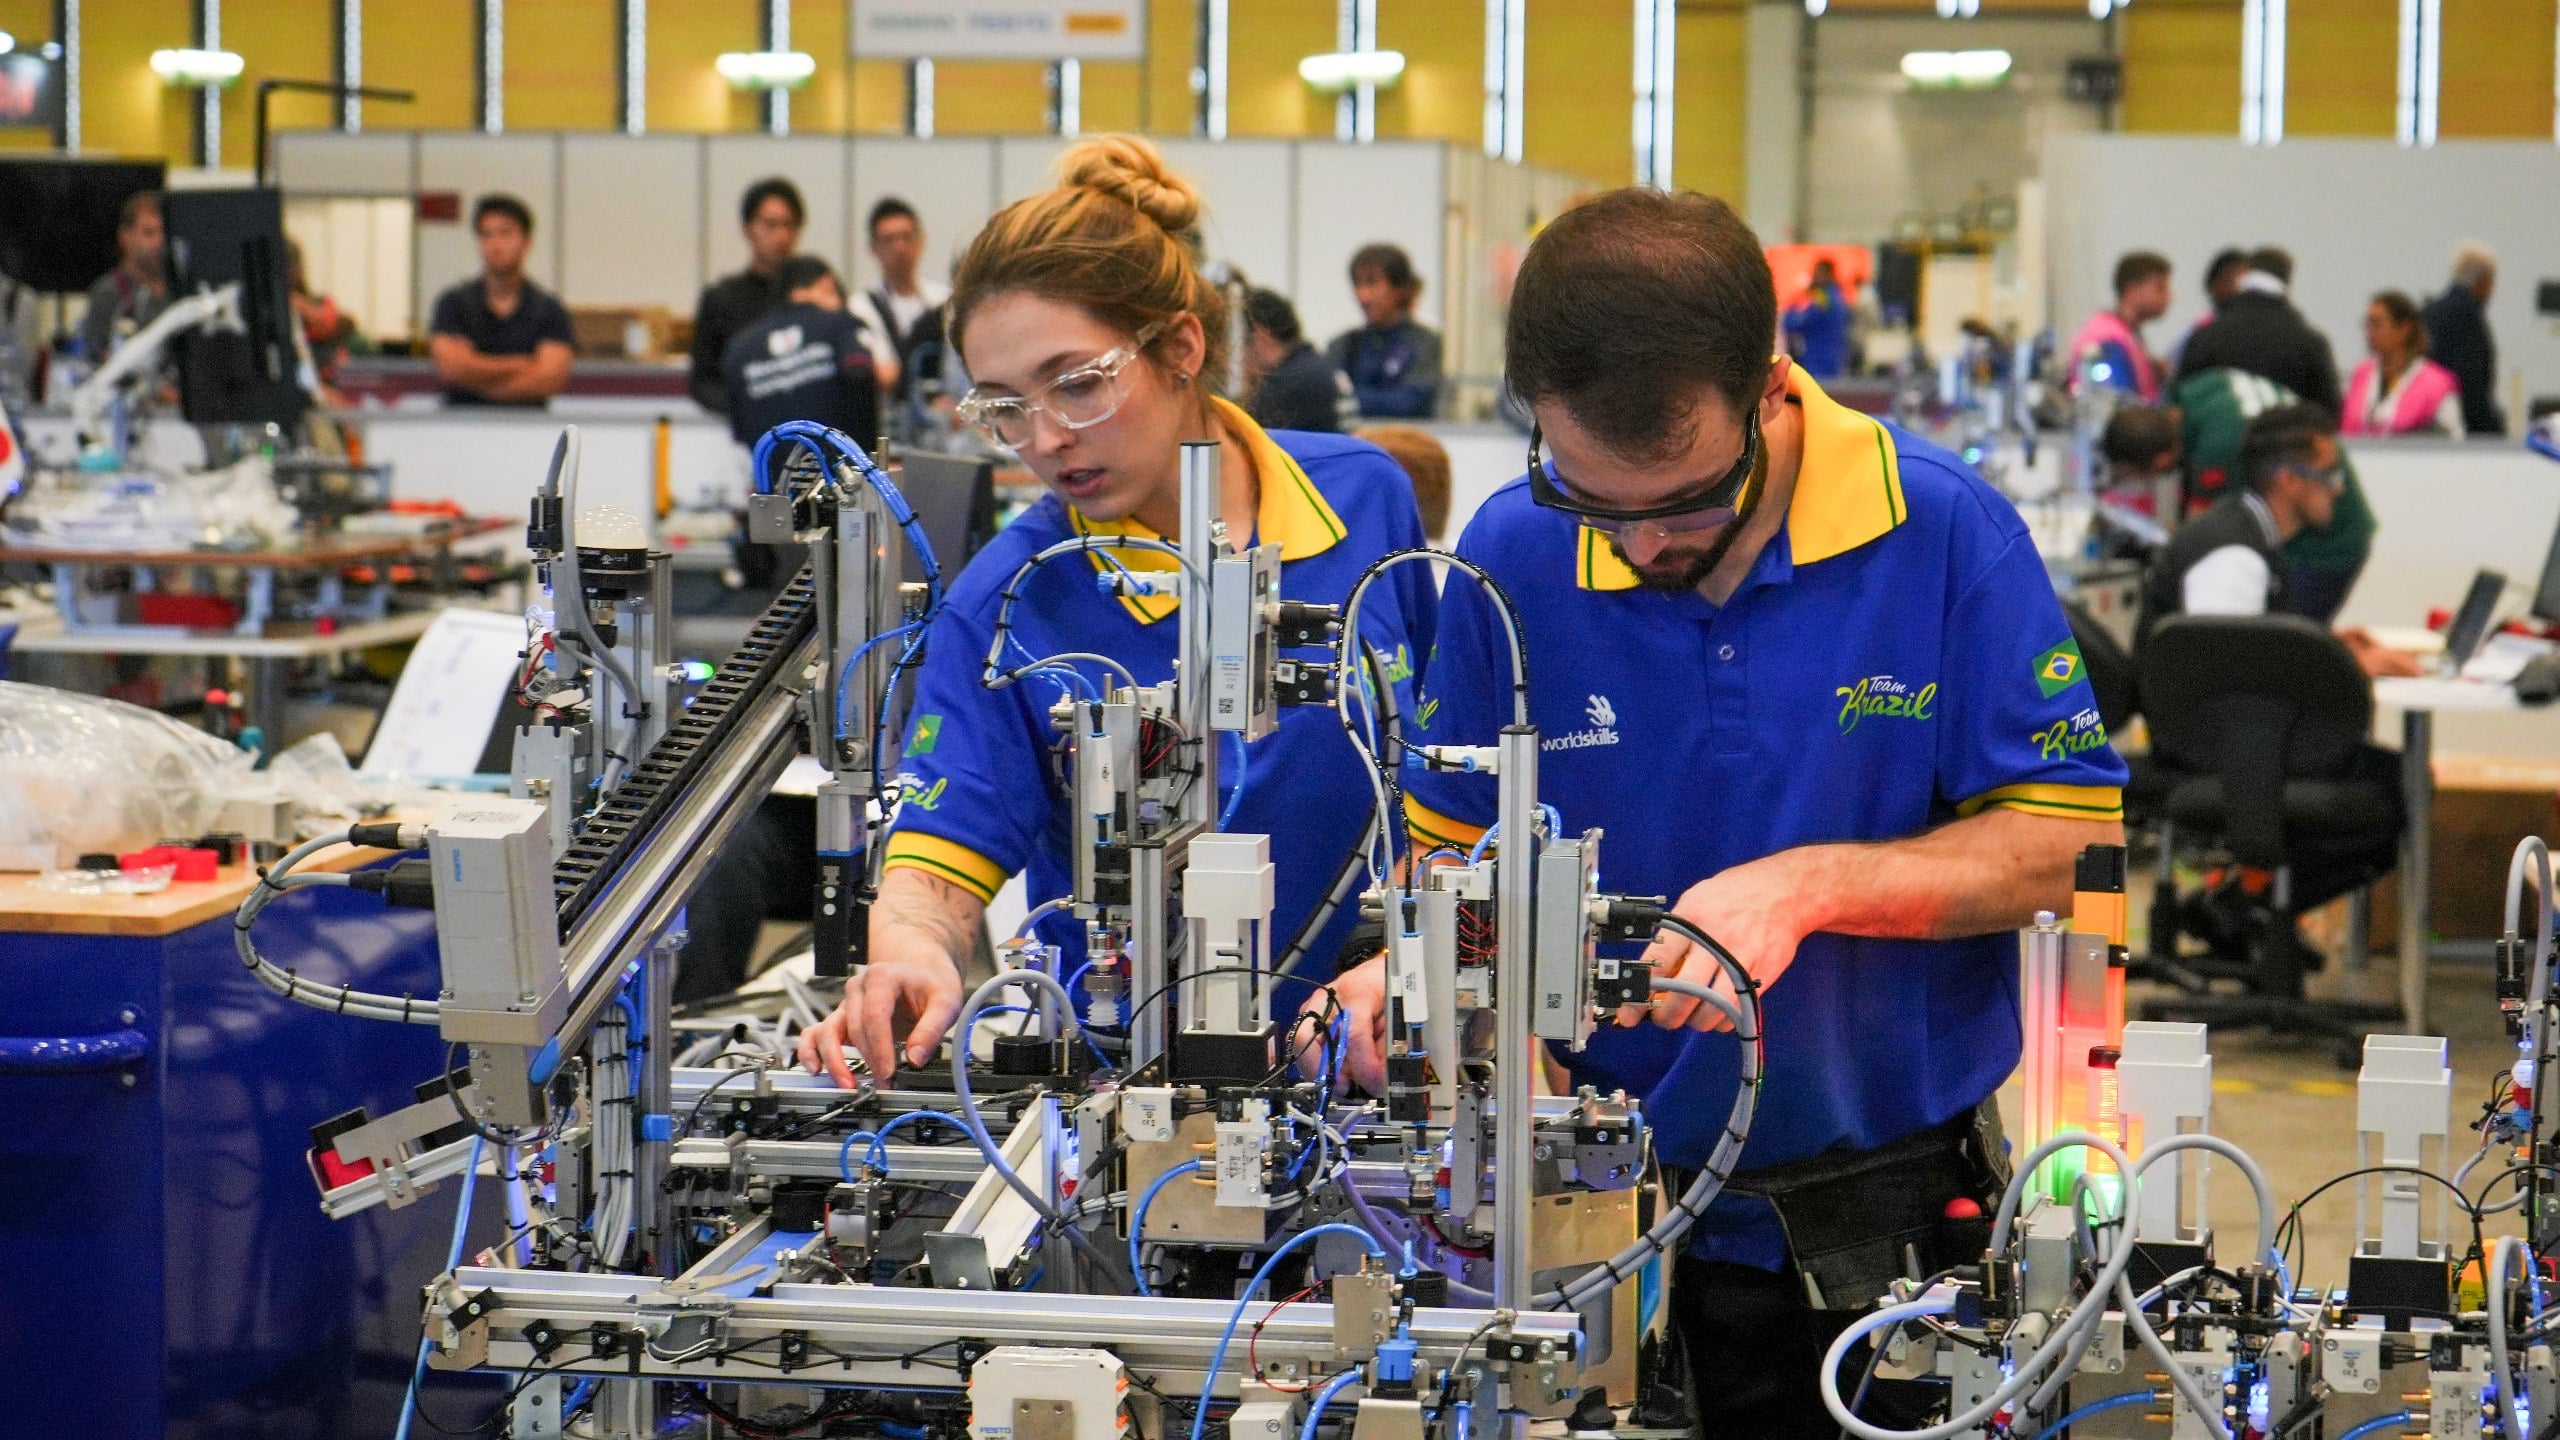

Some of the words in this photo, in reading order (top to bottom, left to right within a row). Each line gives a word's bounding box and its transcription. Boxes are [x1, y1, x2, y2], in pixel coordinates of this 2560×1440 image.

[1870, 675, 1907, 693] Team
[1836, 678, 1937, 736] Brazil
[1541, 727, 1620, 752] worldskills
[2031, 720, 2108, 761] Braz
[979, 1426, 1011, 1434] FESTO
